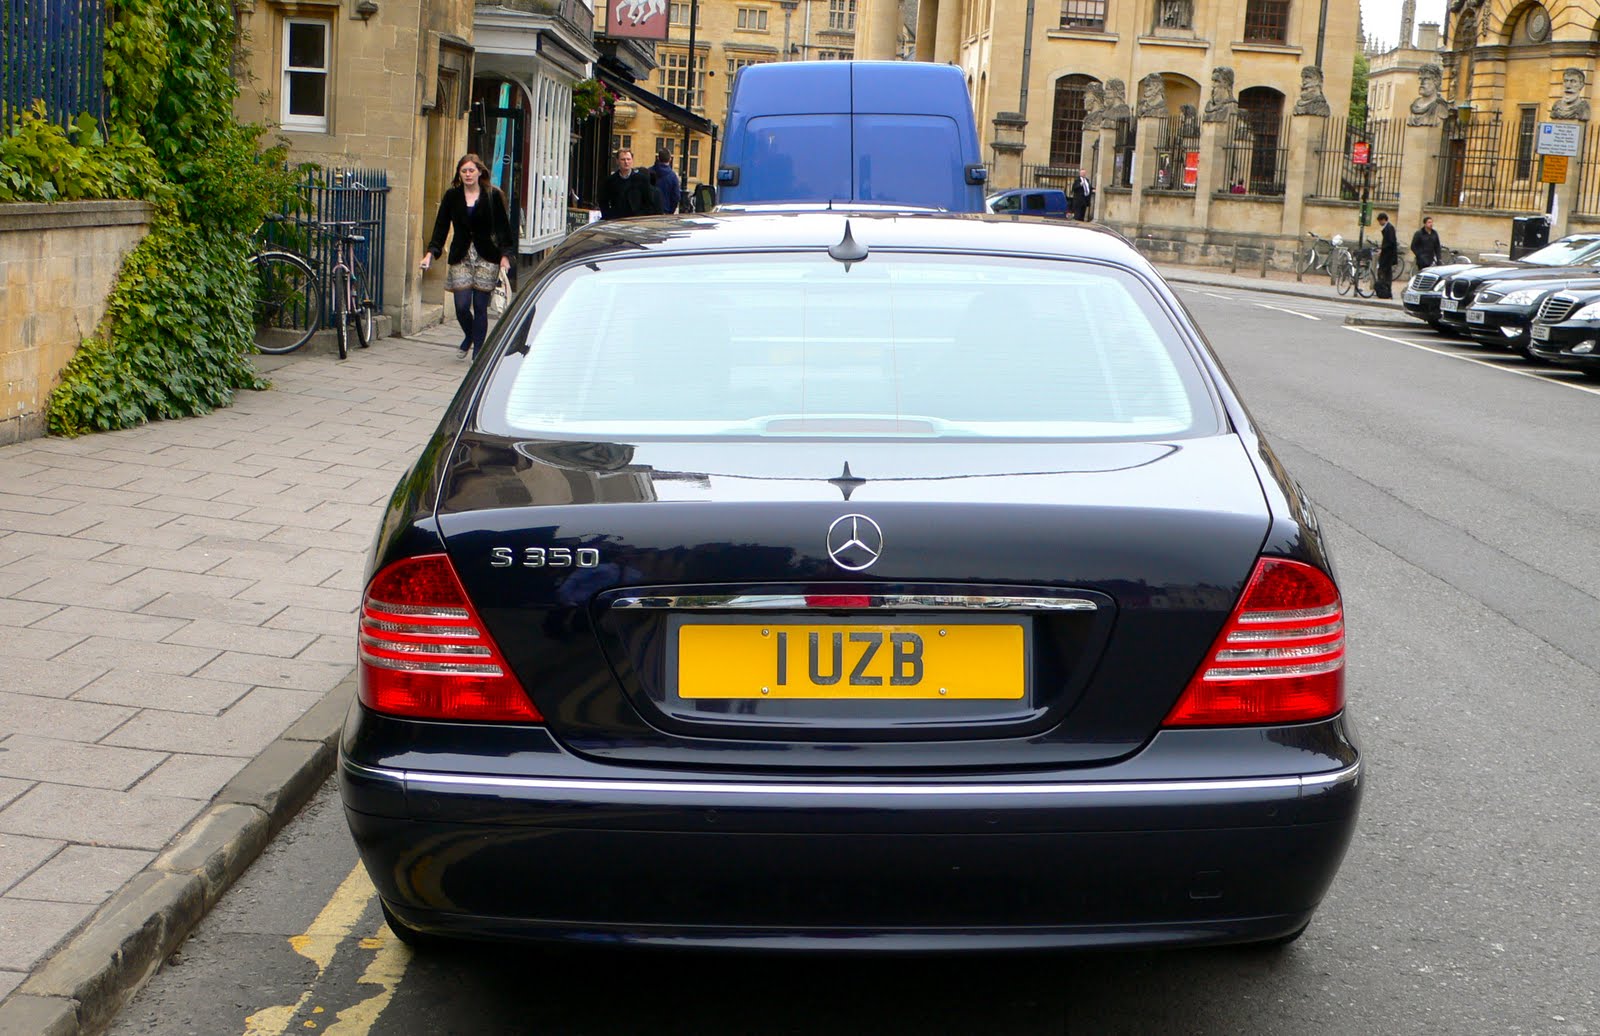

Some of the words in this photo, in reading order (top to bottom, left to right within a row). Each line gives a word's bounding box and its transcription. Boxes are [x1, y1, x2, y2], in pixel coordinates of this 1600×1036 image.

[490, 547, 513, 568] S
[522, 547, 599, 568] 350
[808, 631, 924, 686] UZB
